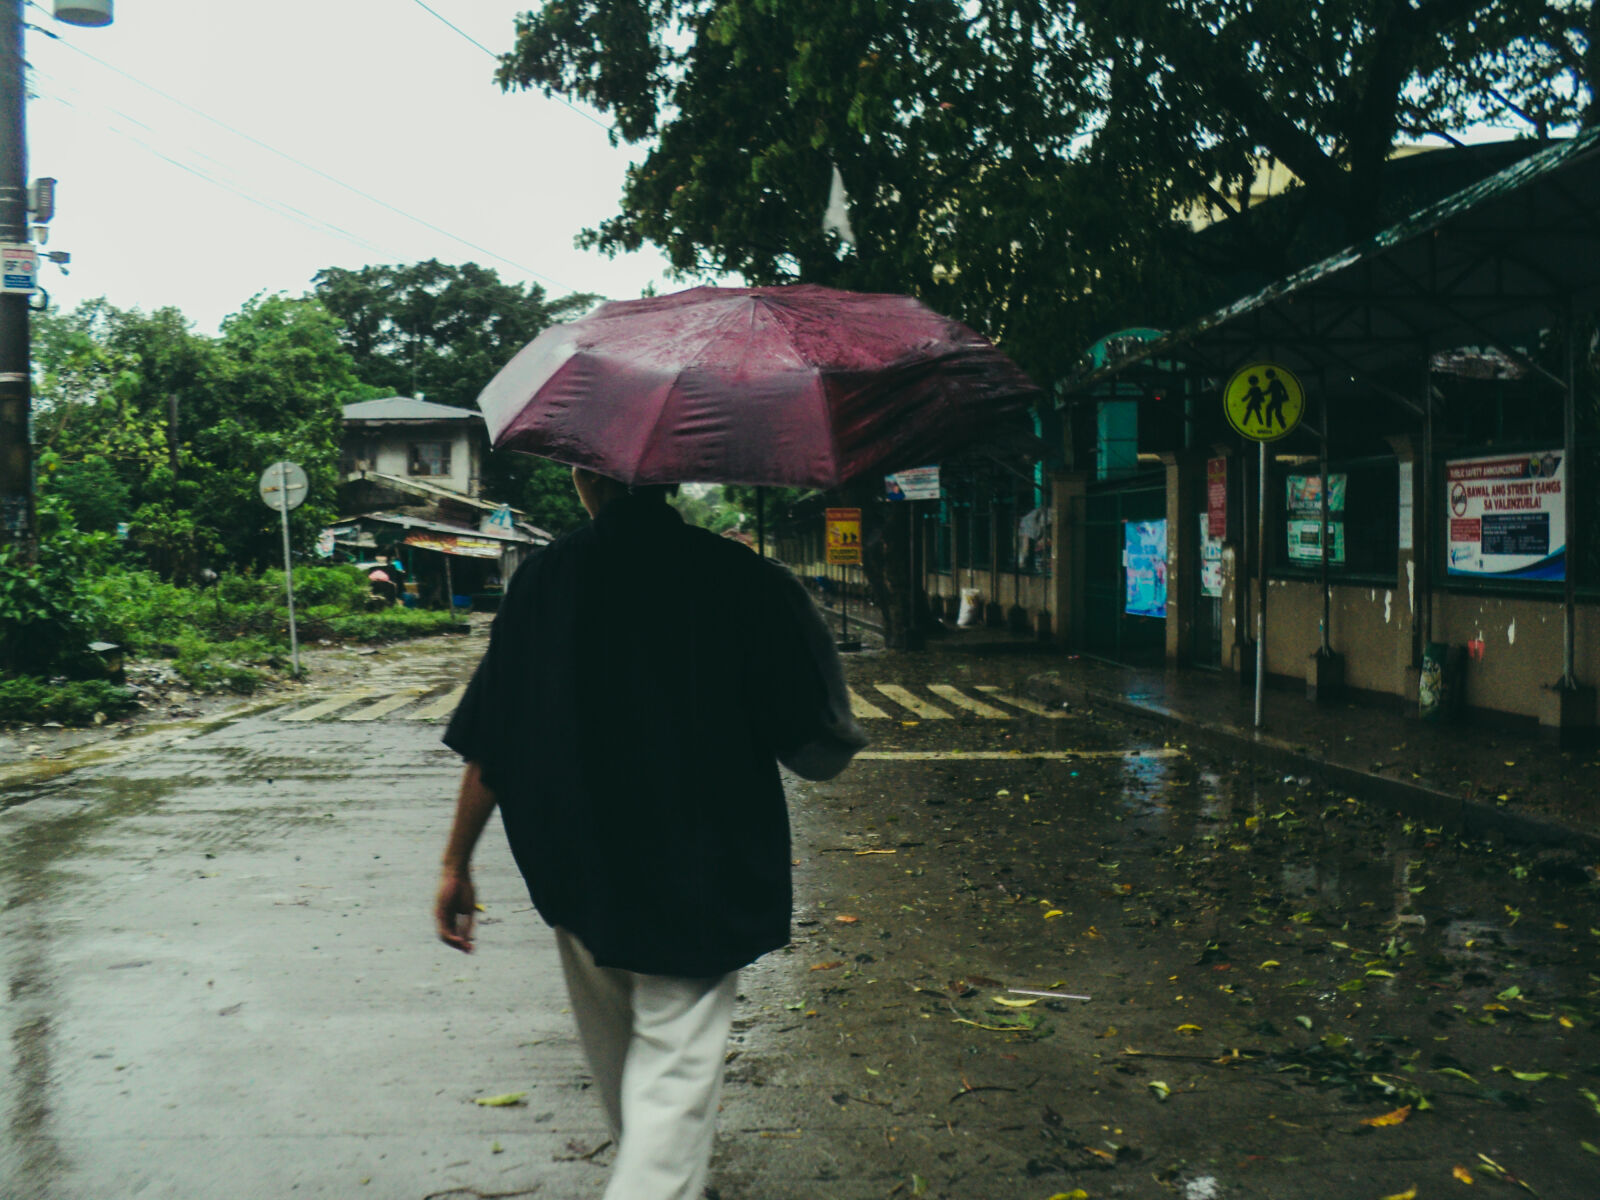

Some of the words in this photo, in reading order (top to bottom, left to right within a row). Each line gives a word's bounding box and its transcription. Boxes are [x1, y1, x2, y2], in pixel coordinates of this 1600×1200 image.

[1465, 467, 1482, 478] SAFETY
[1483, 464, 1521, 476] ANNOUNCEMENT
[1466, 486, 1490, 497] BAWAL
[1491, 484, 1505, 496] ANG
[1506, 483, 1533, 496] STREET
[1535, 481, 1561, 493] GANGS
[1483, 499, 1492, 510] SA
[1494, 497, 1541, 510] VALENZUELA!
